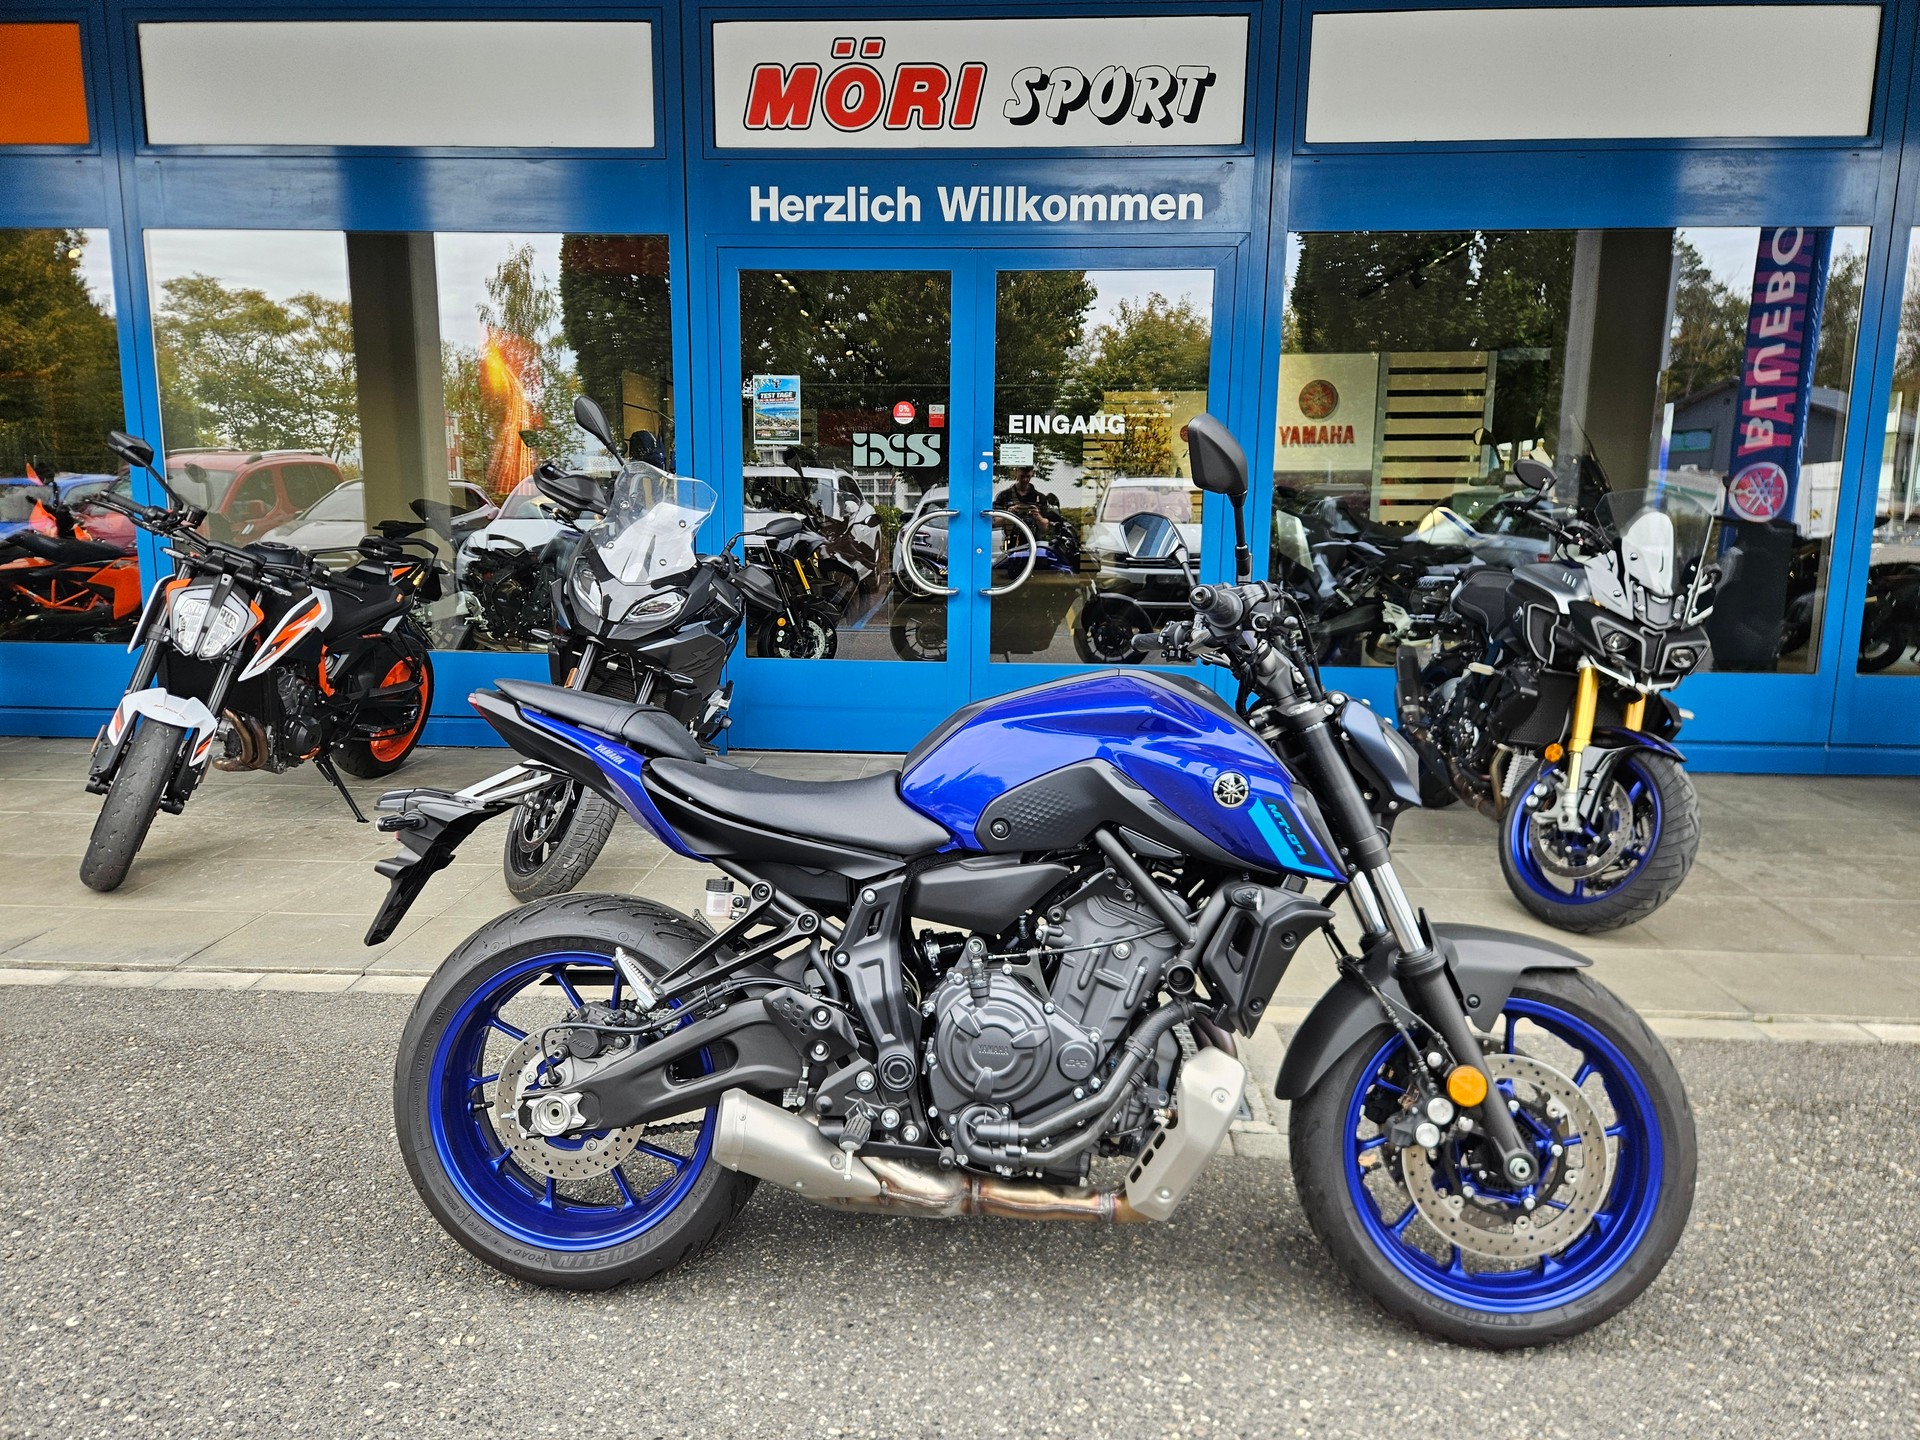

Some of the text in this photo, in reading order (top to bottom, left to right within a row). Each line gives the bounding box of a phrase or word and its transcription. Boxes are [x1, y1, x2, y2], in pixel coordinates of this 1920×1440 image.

[743, 36, 1216, 133] MÖRI SPORT
[750, 186, 1203, 222] Herzlich Willkommen
[1738, 232, 1815, 456] YAMAHA
[1008, 414, 1126, 435] EINGANG
[1279, 425, 1355, 447] YAMAHA
[595, 744, 626, 765] YAMAHA
[1268, 803, 1307, 856] MT-07
[511, 1249, 543, 1264] ROAD
[556, 1226, 667, 1268] MICHELIN
